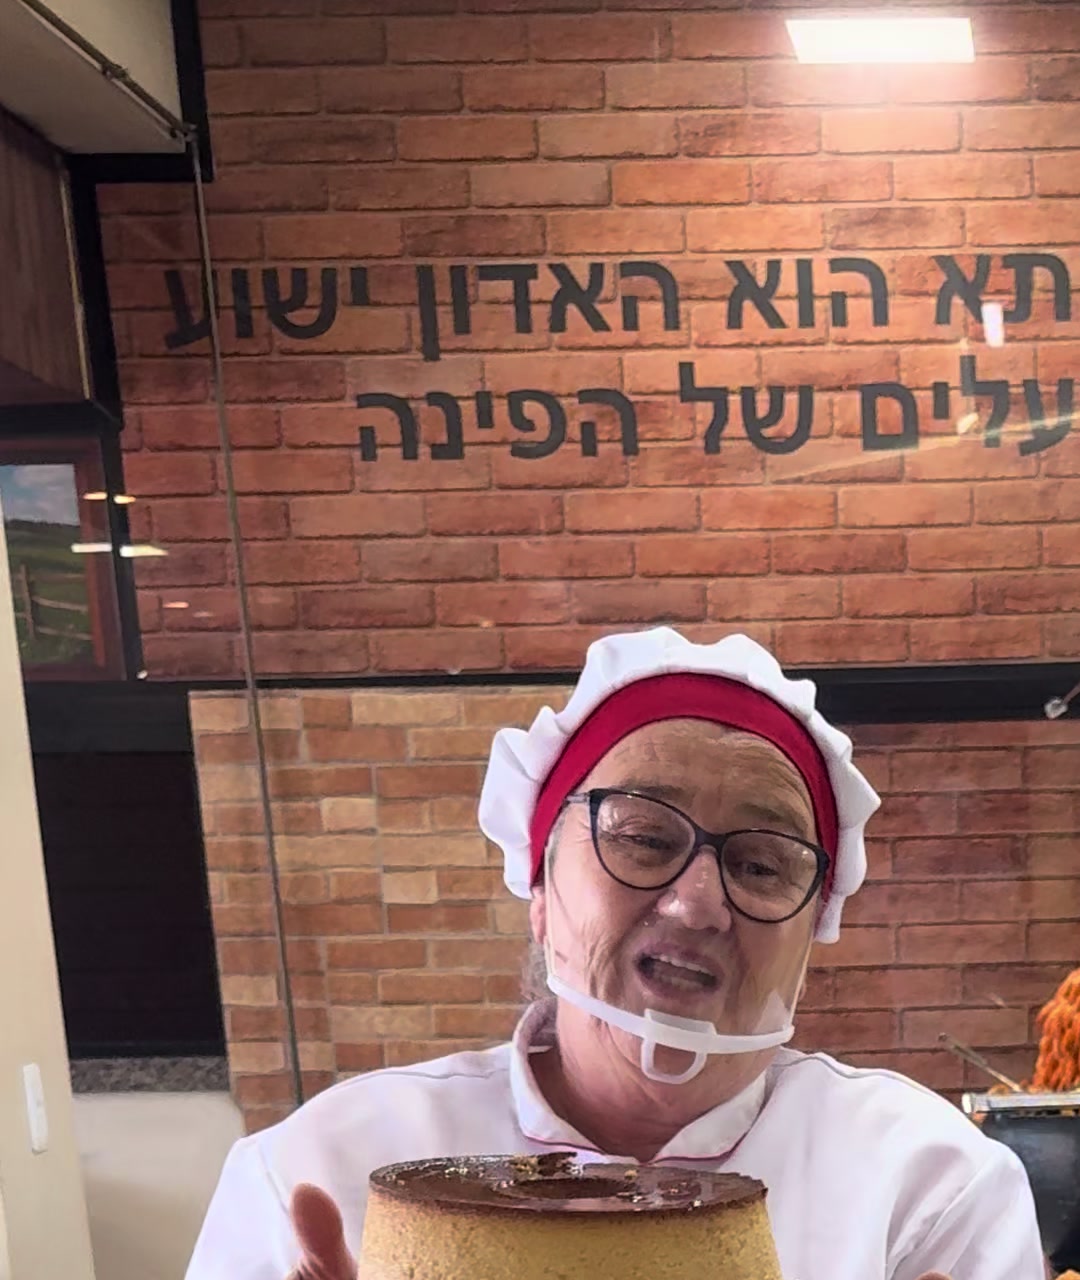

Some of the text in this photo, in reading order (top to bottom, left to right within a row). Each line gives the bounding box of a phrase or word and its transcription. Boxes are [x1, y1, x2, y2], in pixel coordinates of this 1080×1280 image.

[164, 267, 368, 349] ישוע
[415, 261, 680, 362] האדון
[724, 258, 889, 329] הוא
[357, 388, 640, 462] הפינה
[678, 361, 814, 456] של
